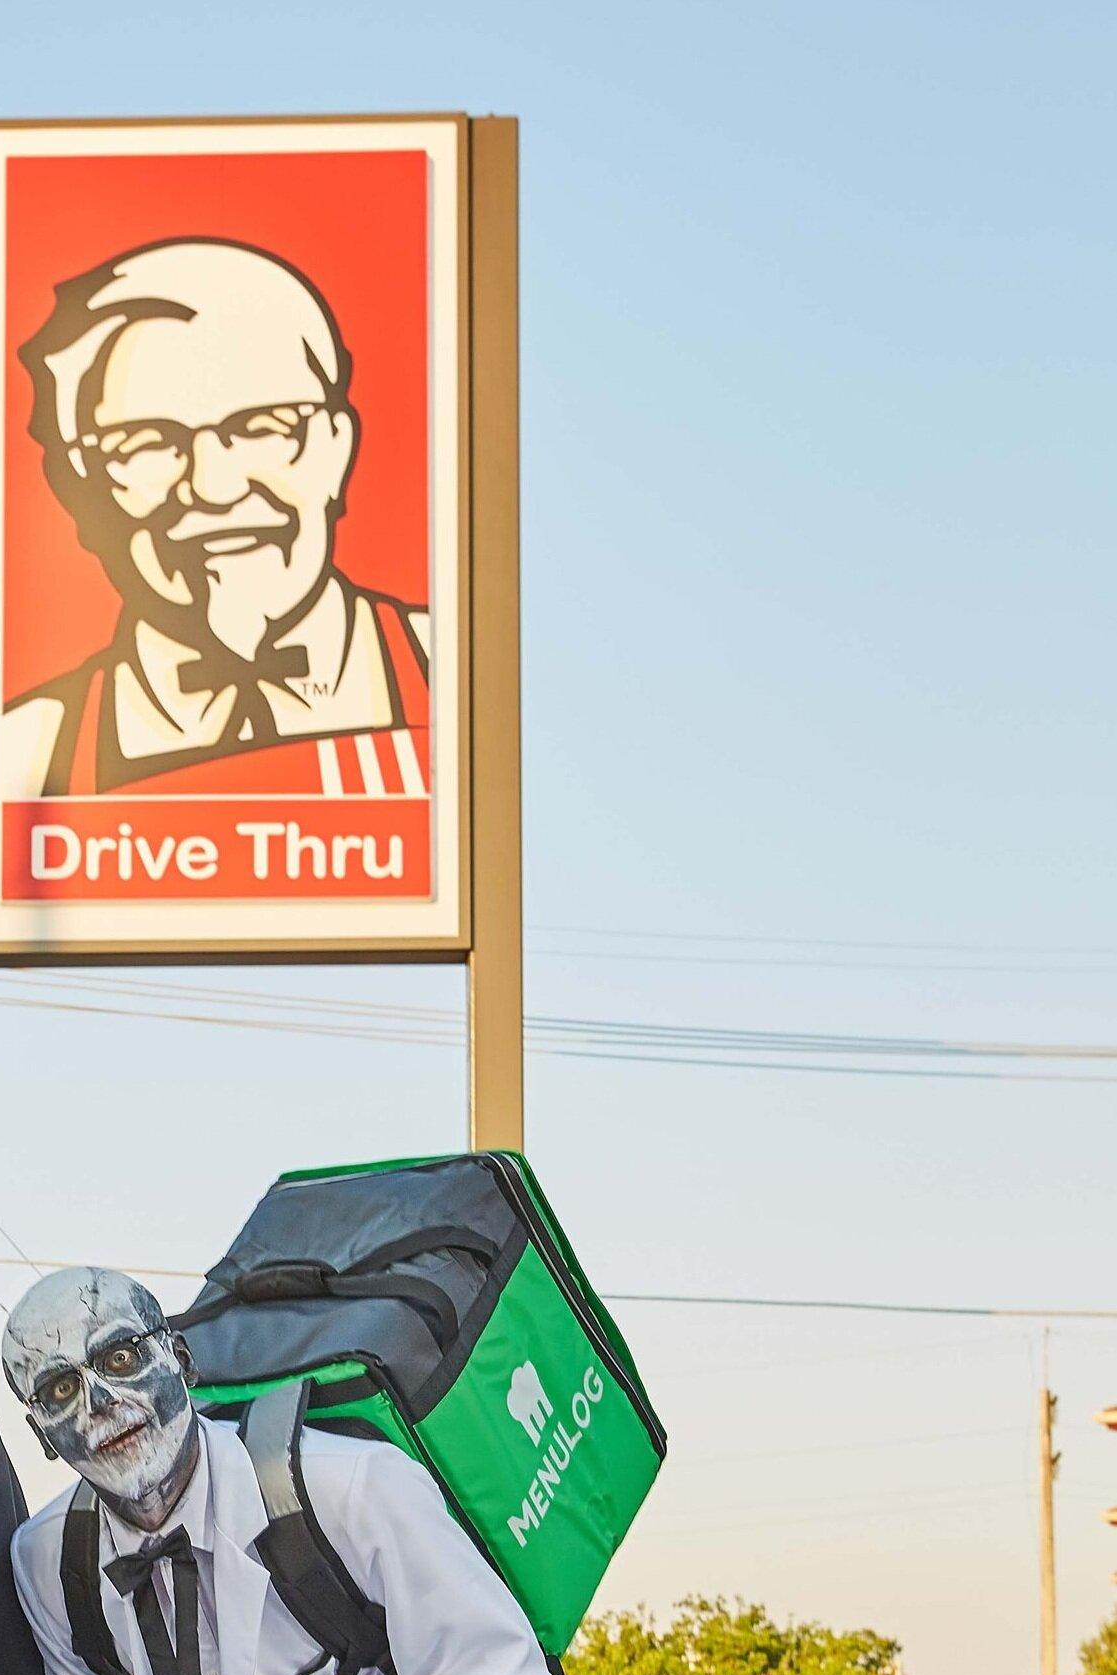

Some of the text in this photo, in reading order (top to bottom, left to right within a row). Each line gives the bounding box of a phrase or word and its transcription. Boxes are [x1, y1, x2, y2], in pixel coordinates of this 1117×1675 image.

[300, 682, 329, 697] TM
[31, 821, 404, 881] Drive Thru
[506, 1366, 604, 1548] MENULOG
